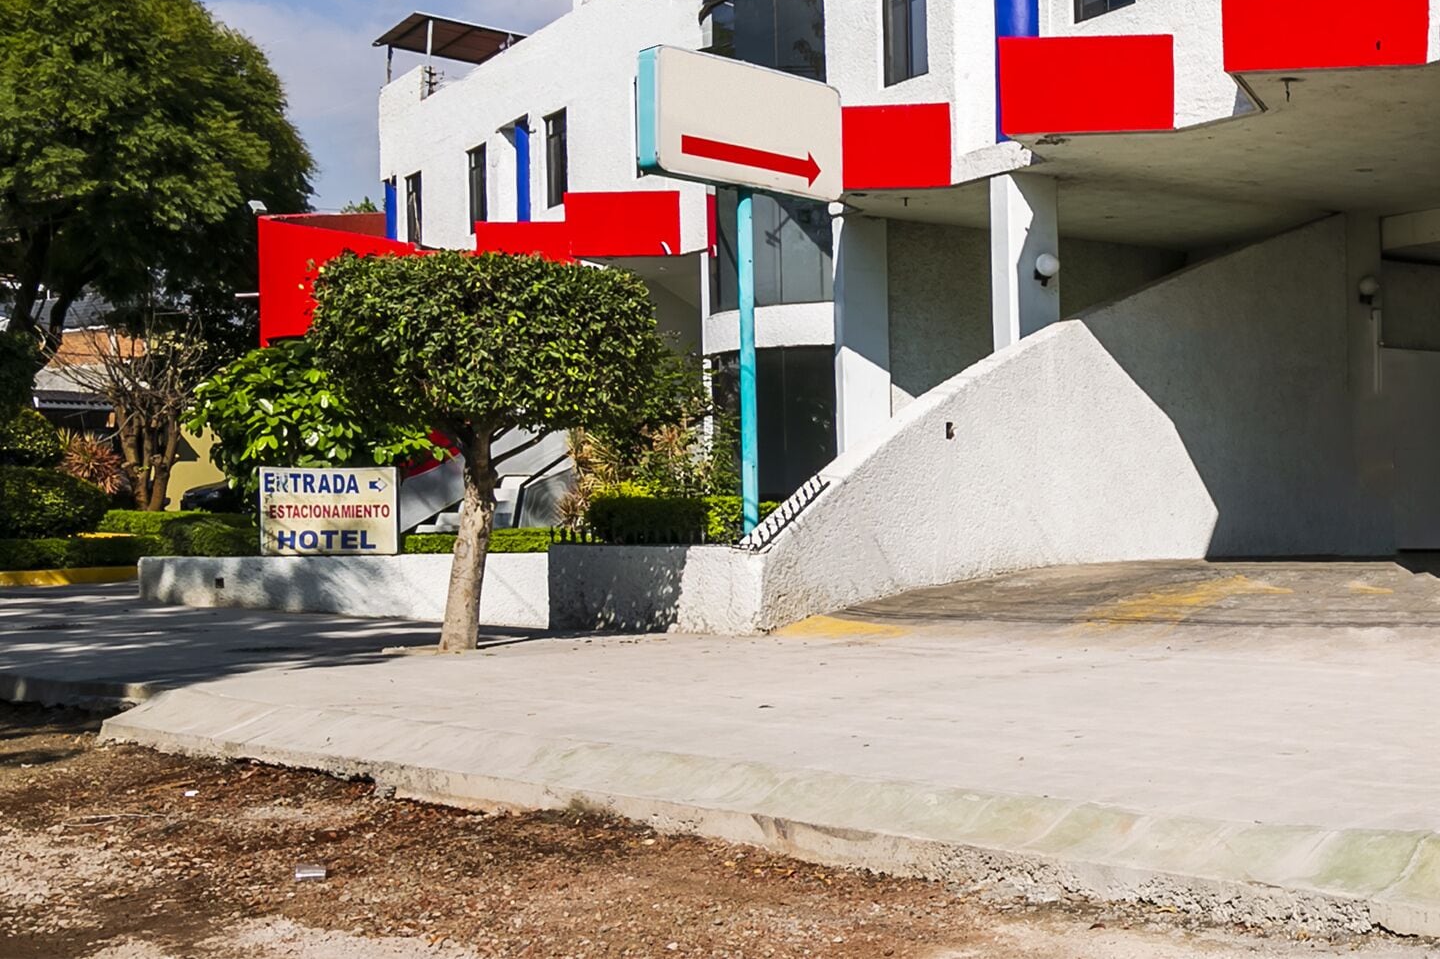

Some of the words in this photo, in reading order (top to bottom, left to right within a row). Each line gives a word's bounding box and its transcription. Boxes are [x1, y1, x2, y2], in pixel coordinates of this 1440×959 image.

[264, 473, 359, 493] ENTRADA
[269, 504, 390, 519] ESTACIONAMIENTO
[278, 530, 376, 550] HOTEL
